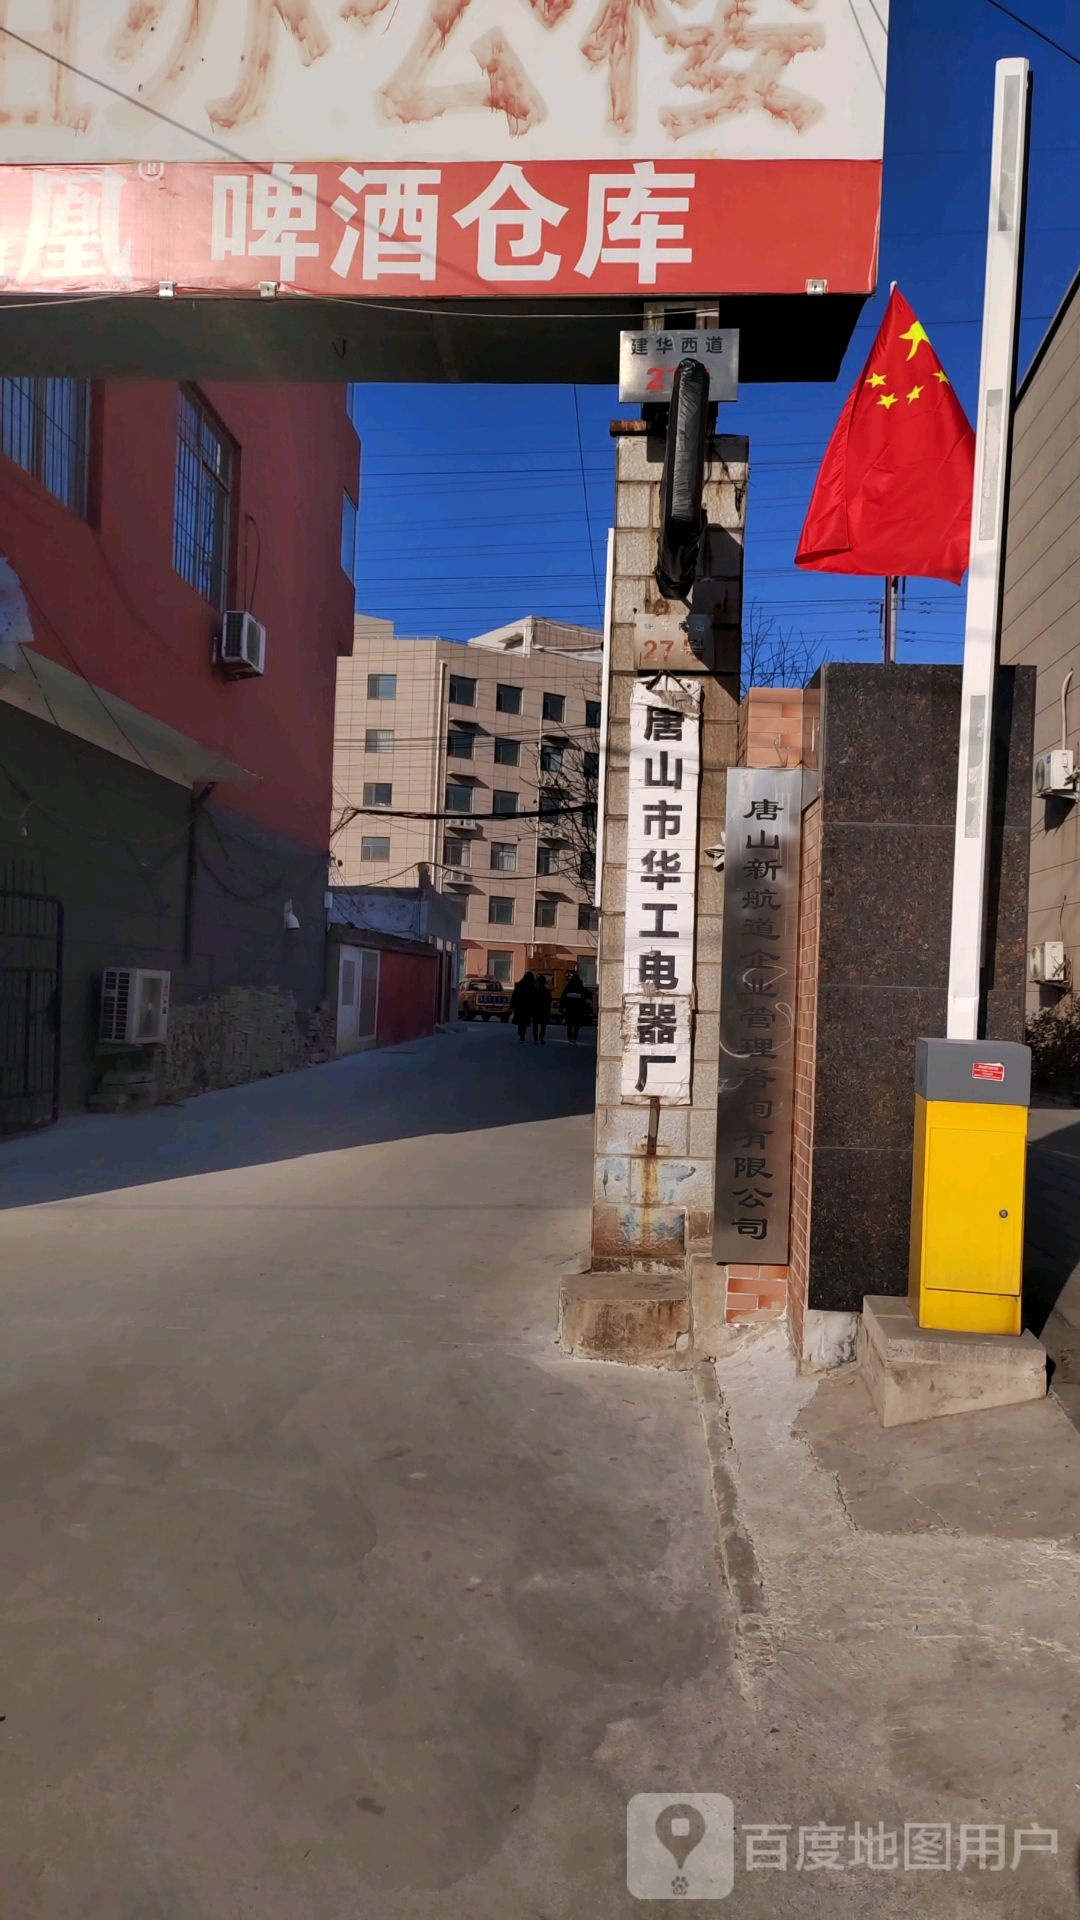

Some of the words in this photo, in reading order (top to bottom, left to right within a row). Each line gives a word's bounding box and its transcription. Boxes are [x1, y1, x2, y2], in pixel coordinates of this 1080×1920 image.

[0, 166, 133, 284] 凰
[210, 162, 696, 284] 啤酒仓库
[631, 336, 723, 356] 建华西道
[634, 706, 686, 1092] 唐山市华工电器厂
